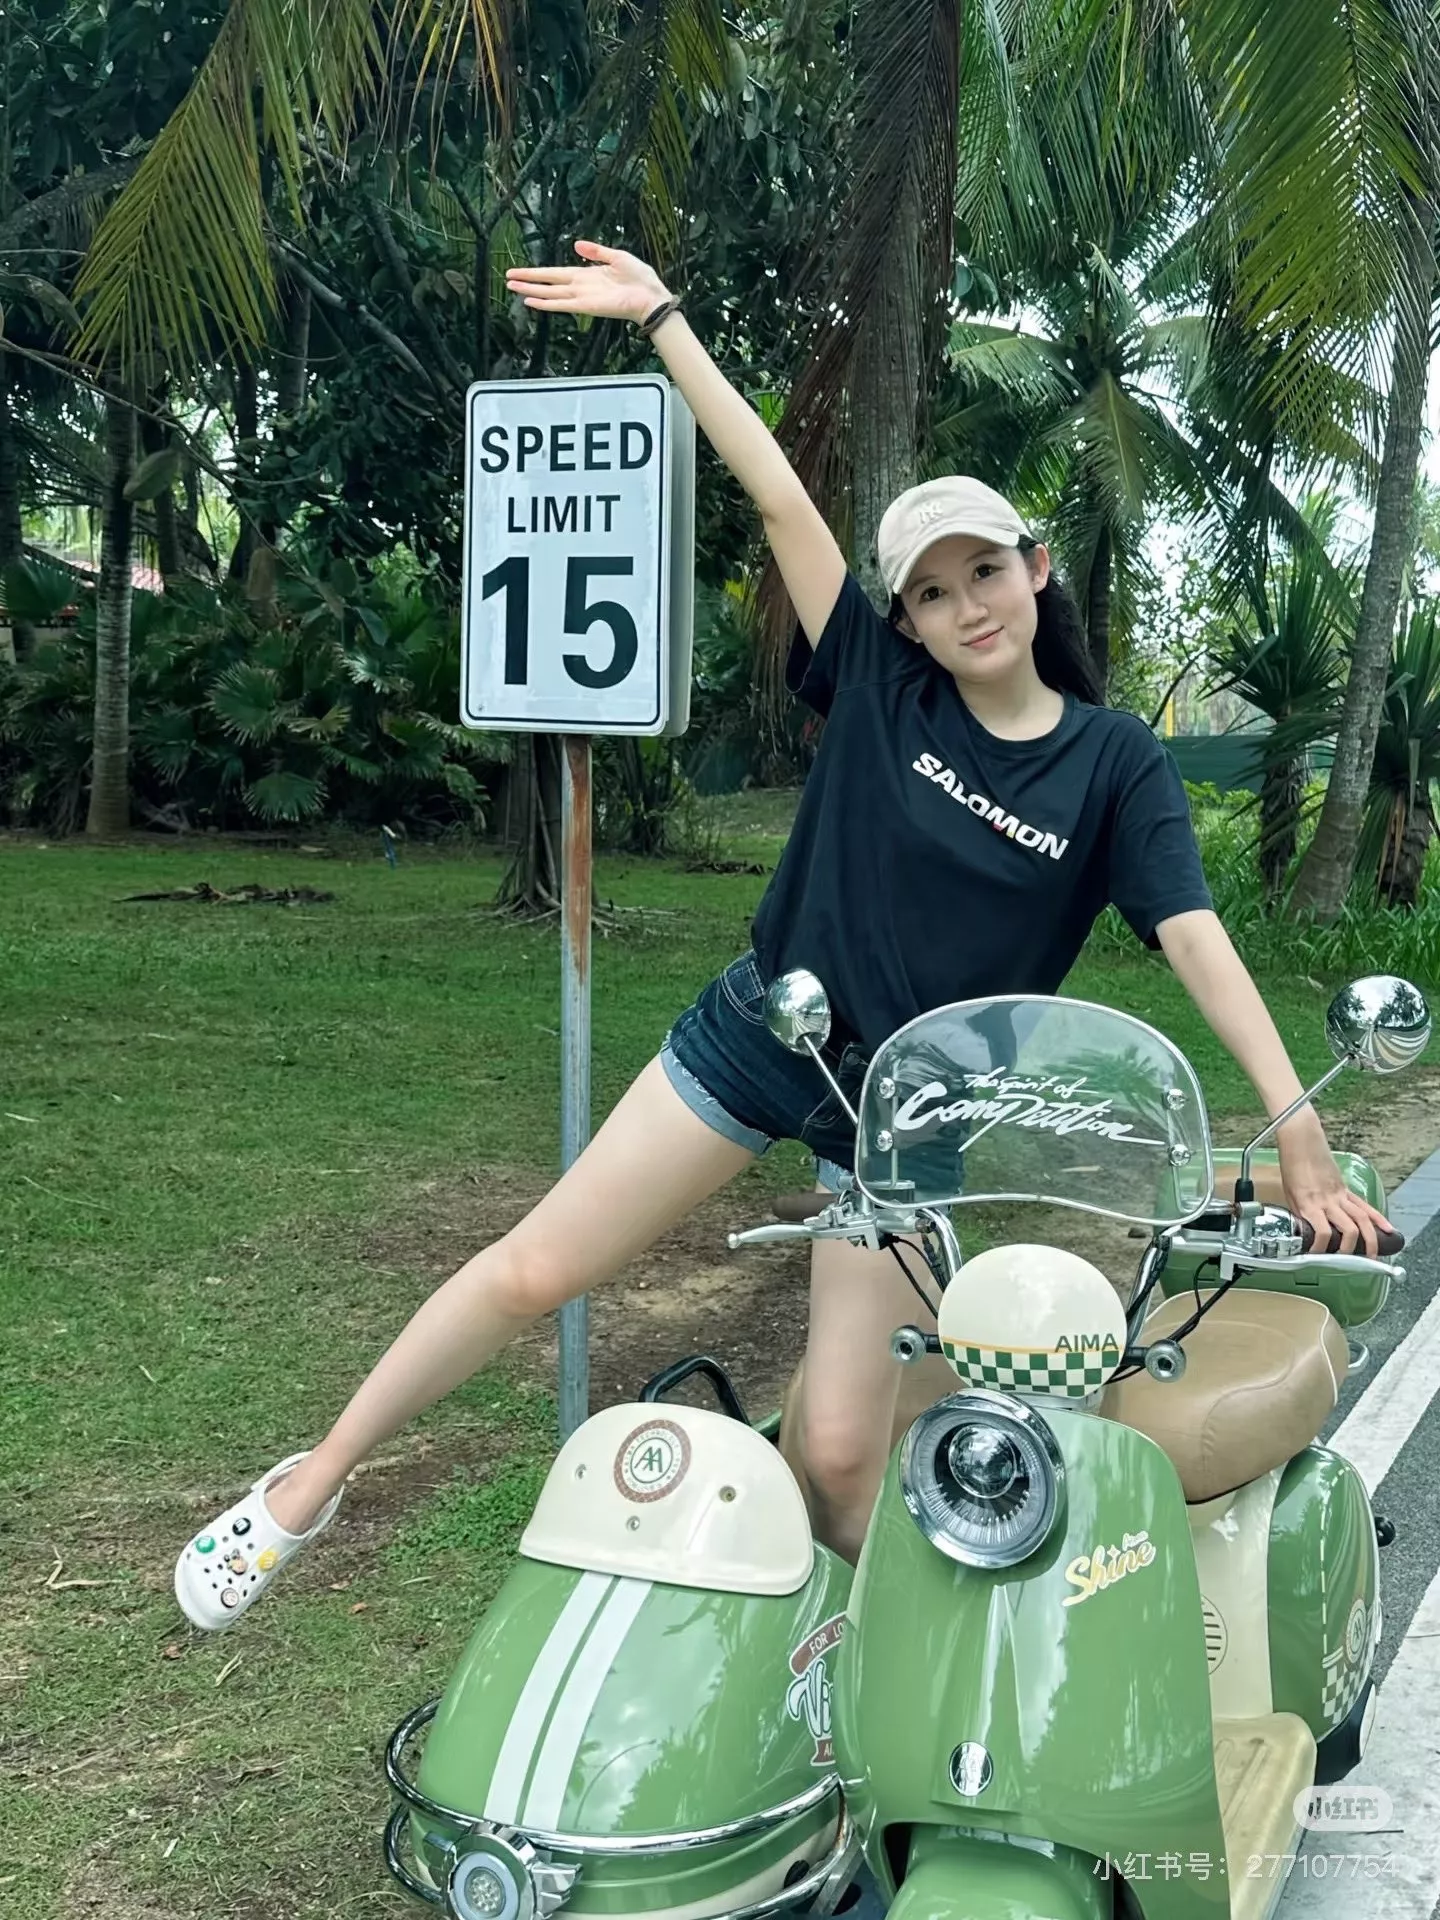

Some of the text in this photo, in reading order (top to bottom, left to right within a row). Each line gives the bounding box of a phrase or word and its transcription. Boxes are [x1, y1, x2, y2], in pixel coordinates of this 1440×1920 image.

[479, 421, 653, 474] SPEED
[507, 495, 621, 533] LIMIT
[482, 556, 639, 690] 15
[912, 752, 1070, 861] SALOMON
[1053, 1076, 1100, 1098] of
[893, 1081, 1166, 1152] Competition
[1054, 1333, 1119, 1353] AIMA
[1062, 1541, 1157, 1607] Shine
[809, 1632, 829, 1655] FOR
